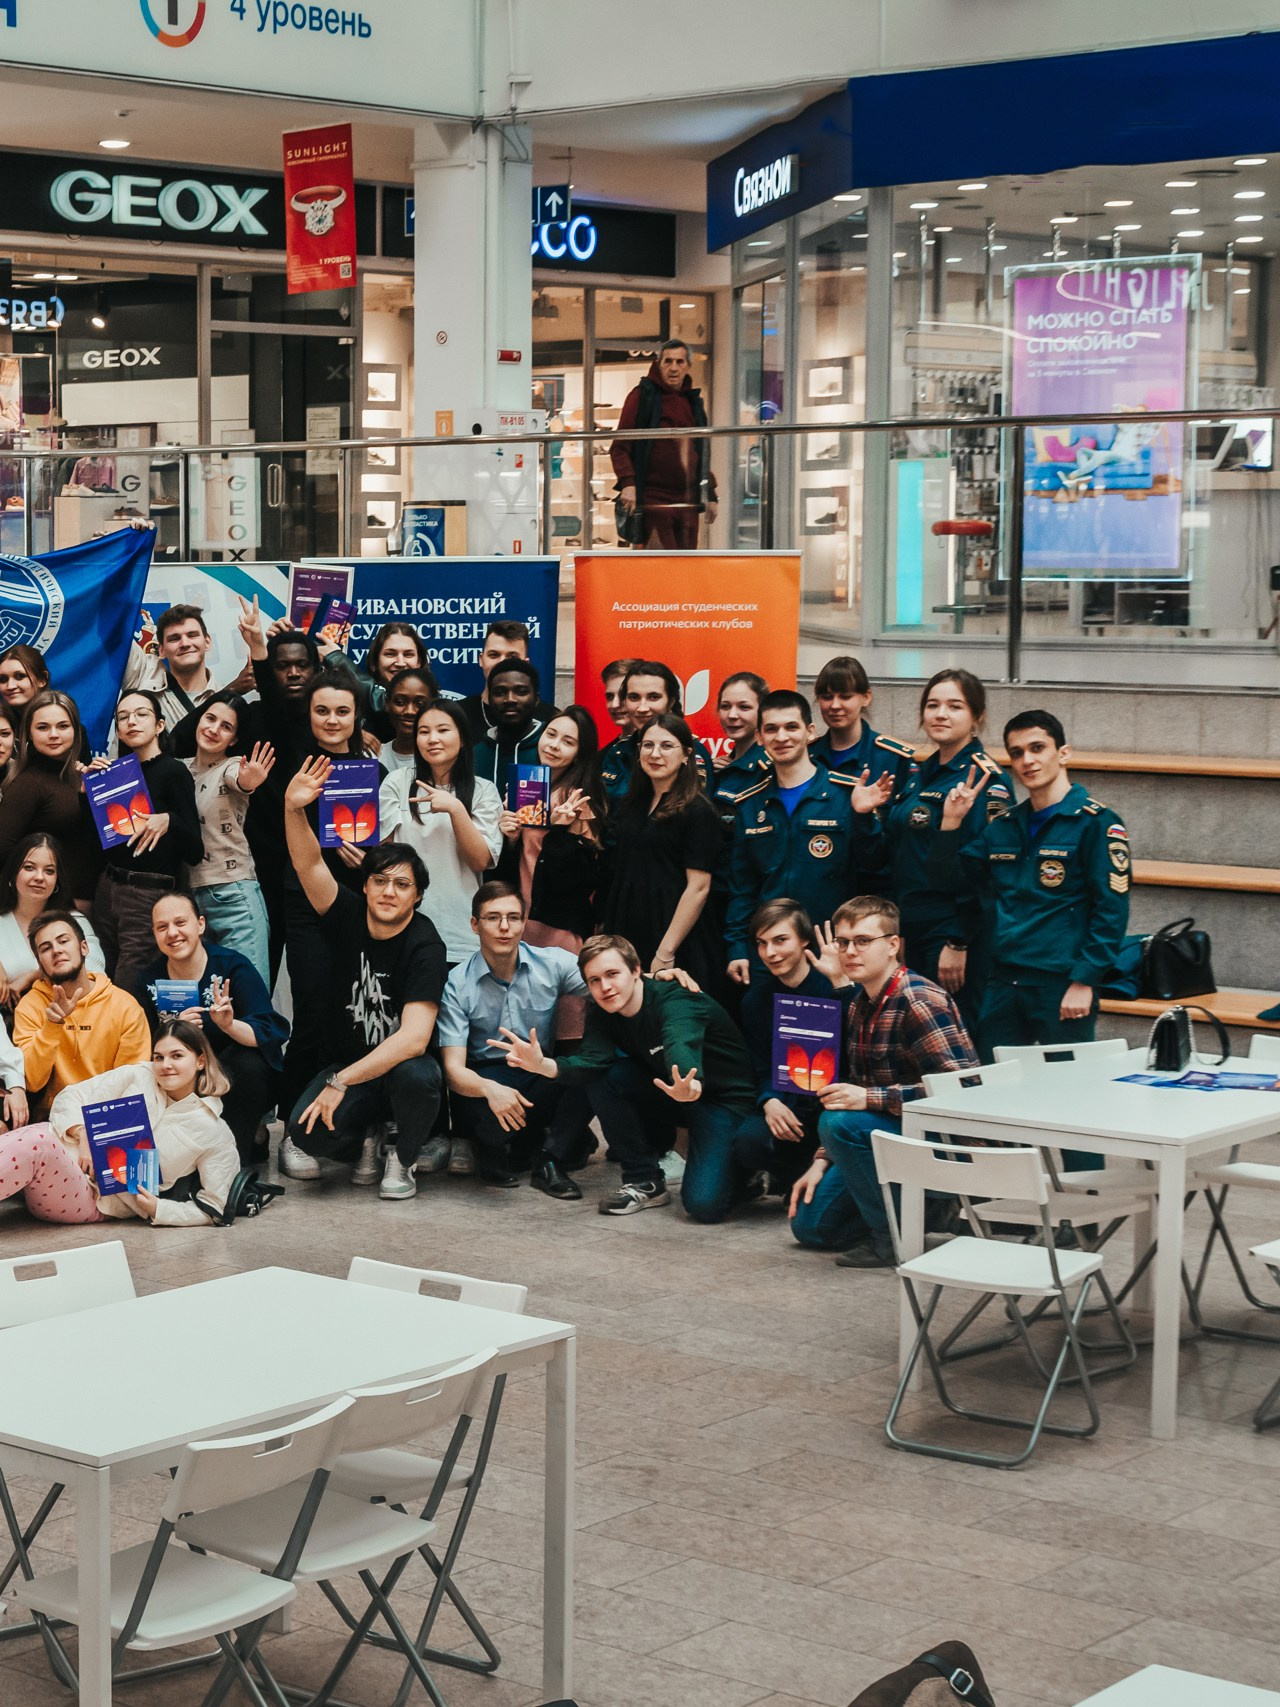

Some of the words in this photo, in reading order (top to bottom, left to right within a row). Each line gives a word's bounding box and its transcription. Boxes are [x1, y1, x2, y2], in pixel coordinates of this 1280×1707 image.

[256, 0, 372, 39] уровень
[286, 141, 348, 160] SUNLIGHT
[51, 170, 269, 235] GEOX
[1027, 310, 1104, 330] МОЖНО
[1109, 305, 1173, 325] СПАТЬ
[1026, 331, 1138, 354] СПОКОЙНО
[82, 346, 161, 368] GEOX
[357, 592, 506, 615] ИВАНОВСКИЙ
[612, 601, 680, 613] Ассоциация
[681, 604, 757, 613] студенческих
[619, 620, 709, 630] патриотических
[711, 618, 753, 630] клубов
